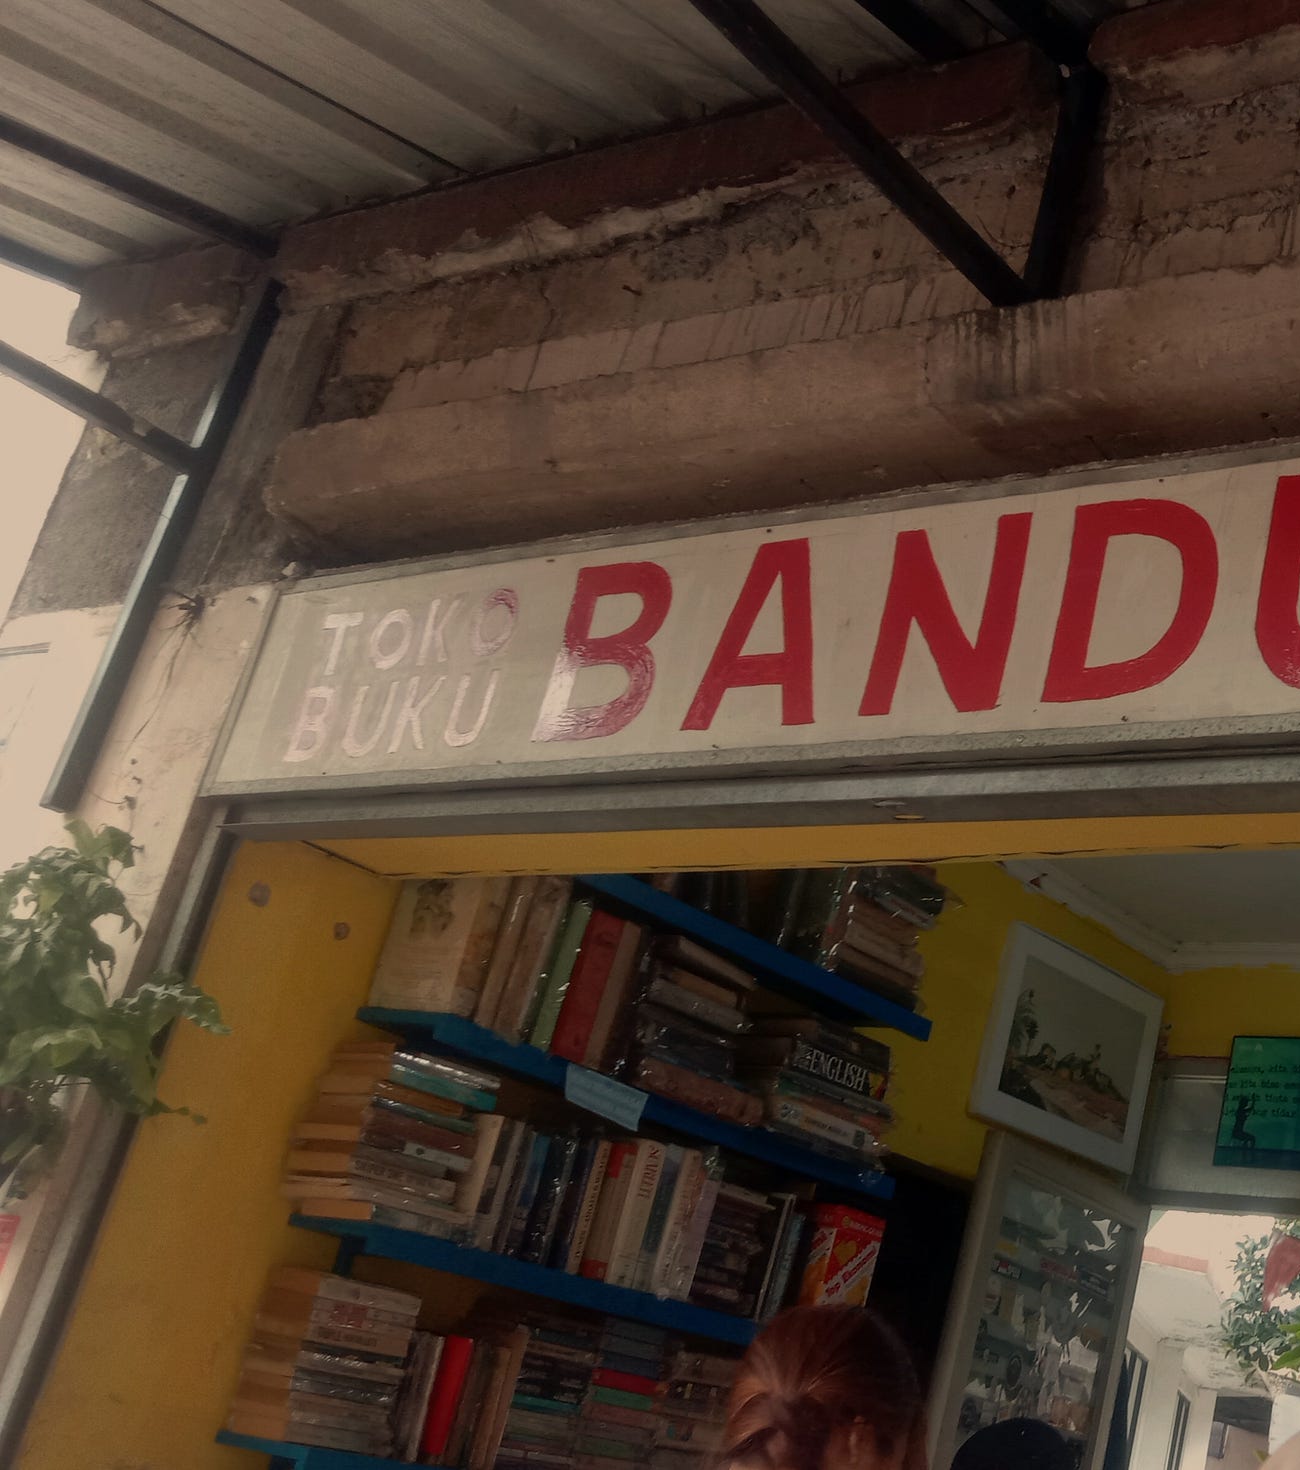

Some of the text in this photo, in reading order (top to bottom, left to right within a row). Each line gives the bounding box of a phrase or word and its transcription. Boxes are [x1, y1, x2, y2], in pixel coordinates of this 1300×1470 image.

[320, 587, 519, 676] TOKO
[282, 668, 503, 762] BUKU
[809, 1049, 868, 1091] ENGLISH
